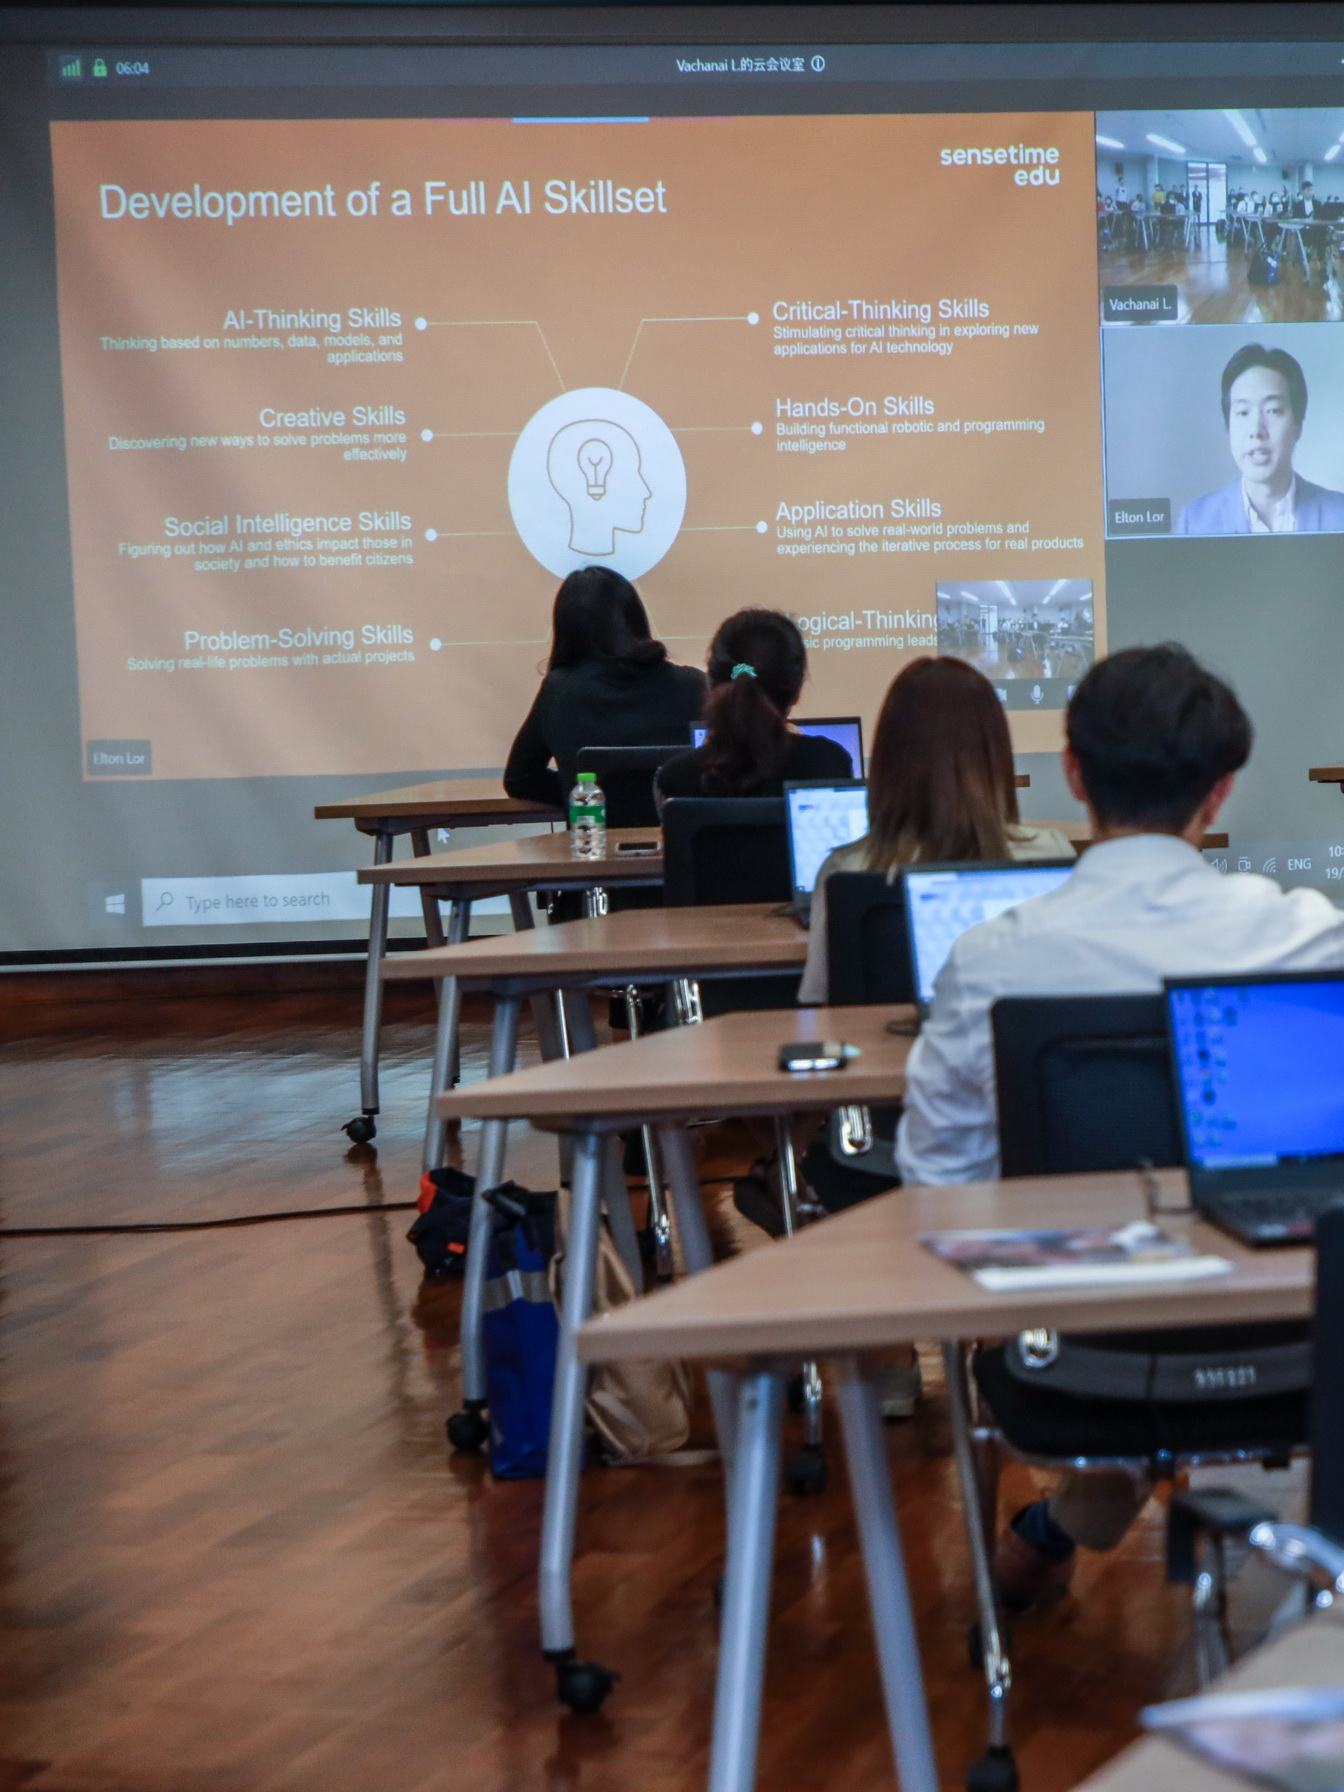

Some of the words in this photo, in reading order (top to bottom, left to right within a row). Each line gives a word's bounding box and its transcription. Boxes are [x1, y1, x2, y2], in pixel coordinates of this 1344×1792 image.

[676, 59, 728, 72] Vachanai
[940, 144, 1059, 166] sensetime
[1014, 166, 1060, 186] edu
[100, 184, 336, 226] Development
[347, 181, 381, 216] of
[391, 189, 411, 216] a
[425, 181, 485, 215] Full
[496, 180, 530, 214] AI
[545, 180, 667, 214] Skillset
[773, 300, 931, 323] Critical-Thinking
[939, 299, 989, 318] Skills
[1110, 298, 1159, 310] Vachanai
[1163, 298, 1171, 309] L.
[223, 309, 341, 332] AI-Thinking
[348, 308, 401, 328] Skills
[774, 326, 841, 340] Stimulating
[846, 325, 884, 337] critical
[888, 324, 935, 339] thinking
[940, 324, 950, 336] in
[955, 323, 1009, 337] exploring
[1014, 324, 1039, 334] new
[101, 337, 156, 352] Thinking
[161, 336, 199, 348] based
[203, 338, 219, 348] on
[224, 336, 283, 349] numbers,
[288, 335, 318, 348] data,
[324, 334, 373, 347] models,
[378, 334, 402, 346] and
[774, 343, 847, 357] applications
[851, 342, 866, 353] for
[870, 342, 882, 353] AI
[887, 341, 953, 355] technology
[327, 351, 403, 365] applications
[776, 398, 876, 418] Hands-On
[883, 396, 934, 415] Skills
[259, 407, 345, 428] Creative
[352, 406, 405, 425] Skills
[777, 422, 825, 437] Building
[829, 421, 888, 434] functional
[892, 420, 933, 433] robotic
[937, 420, 960, 432] and
[964, 419, 1045, 434] programming
[109, 436, 186, 450] Discovering
[190, 436, 217, 447] new
[221, 435, 253, 449] ways
[257, 434, 270, 446] to
[274, 433, 306, 446] solve
[311, 432, 370, 447] problems
[374, 433, 406, 444] more
[777, 439, 846, 453] intelligence
[343, 447, 407, 462] effectively
[776, 501, 883, 523] Application
[891, 499, 941, 518] Skills
[1115, 511, 1143, 523] Elton
[1147, 511, 1164, 522] Lor
[165, 516, 228, 537] Social
[236, 513, 352, 537] Intelligence
[359, 511, 411, 532] Skills
[777, 526, 811, 540] Using
[815, 525, 828, 537] AI
[832, 525, 843, 537] to
[847, 524, 879, 536] solve
[883, 523, 943, 535] real-world
[947, 522, 1003, 537] problems
[1007, 522, 1029, 533] and
[119, 543, 171, 558] Figuring
[175, 542, 195, 555] out
[199, 541, 226, 554] how
[229, 539, 243, 552] AI
[247, 539, 271, 552] and
[276, 538, 313, 551] ethics
[317, 537, 359, 552] impact
[363, 536, 397, 550] those
[401, 536, 412, 548] in
[777, 541, 855, 555] experiencing
[859, 540, 877, 553] the
[882, 539, 929, 551] iterative
[934, 540, 981, 553] process
[985, 538, 1000, 550] for
[1004, 537, 1028, 549] real
[1032, 537, 1084, 551] products
[195, 557, 240, 572] society
[245, 556, 269, 569] and
[273, 555, 300, 567] how
[304, 555, 316, 566] to
[320, 554, 362, 566] benefit
[366, 552, 413, 565] citizens
[184, 627, 354, 651] Problem-Solving
[361, 624, 413, 645] Skills
[824, 635, 903, 650] programming
[127, 657, 174, 672] Solving
[179, 655, 225, 669] real-life
[229, 654, 288, 670] problems
[292, 652, 318, 665] with
[323, 651, 361, 664] actual
[365, 650, 415, 665] projects
[93, 752, 123, 764] Elton
[127, 752, 144, 764] Lor
[1288, 859, 1311, 870] ENG
[186, 895, 221, 914] Type
[226, 894, 258, 909] here
[263, 895, 278, 907] to
[283, 891, 330, 907] search
